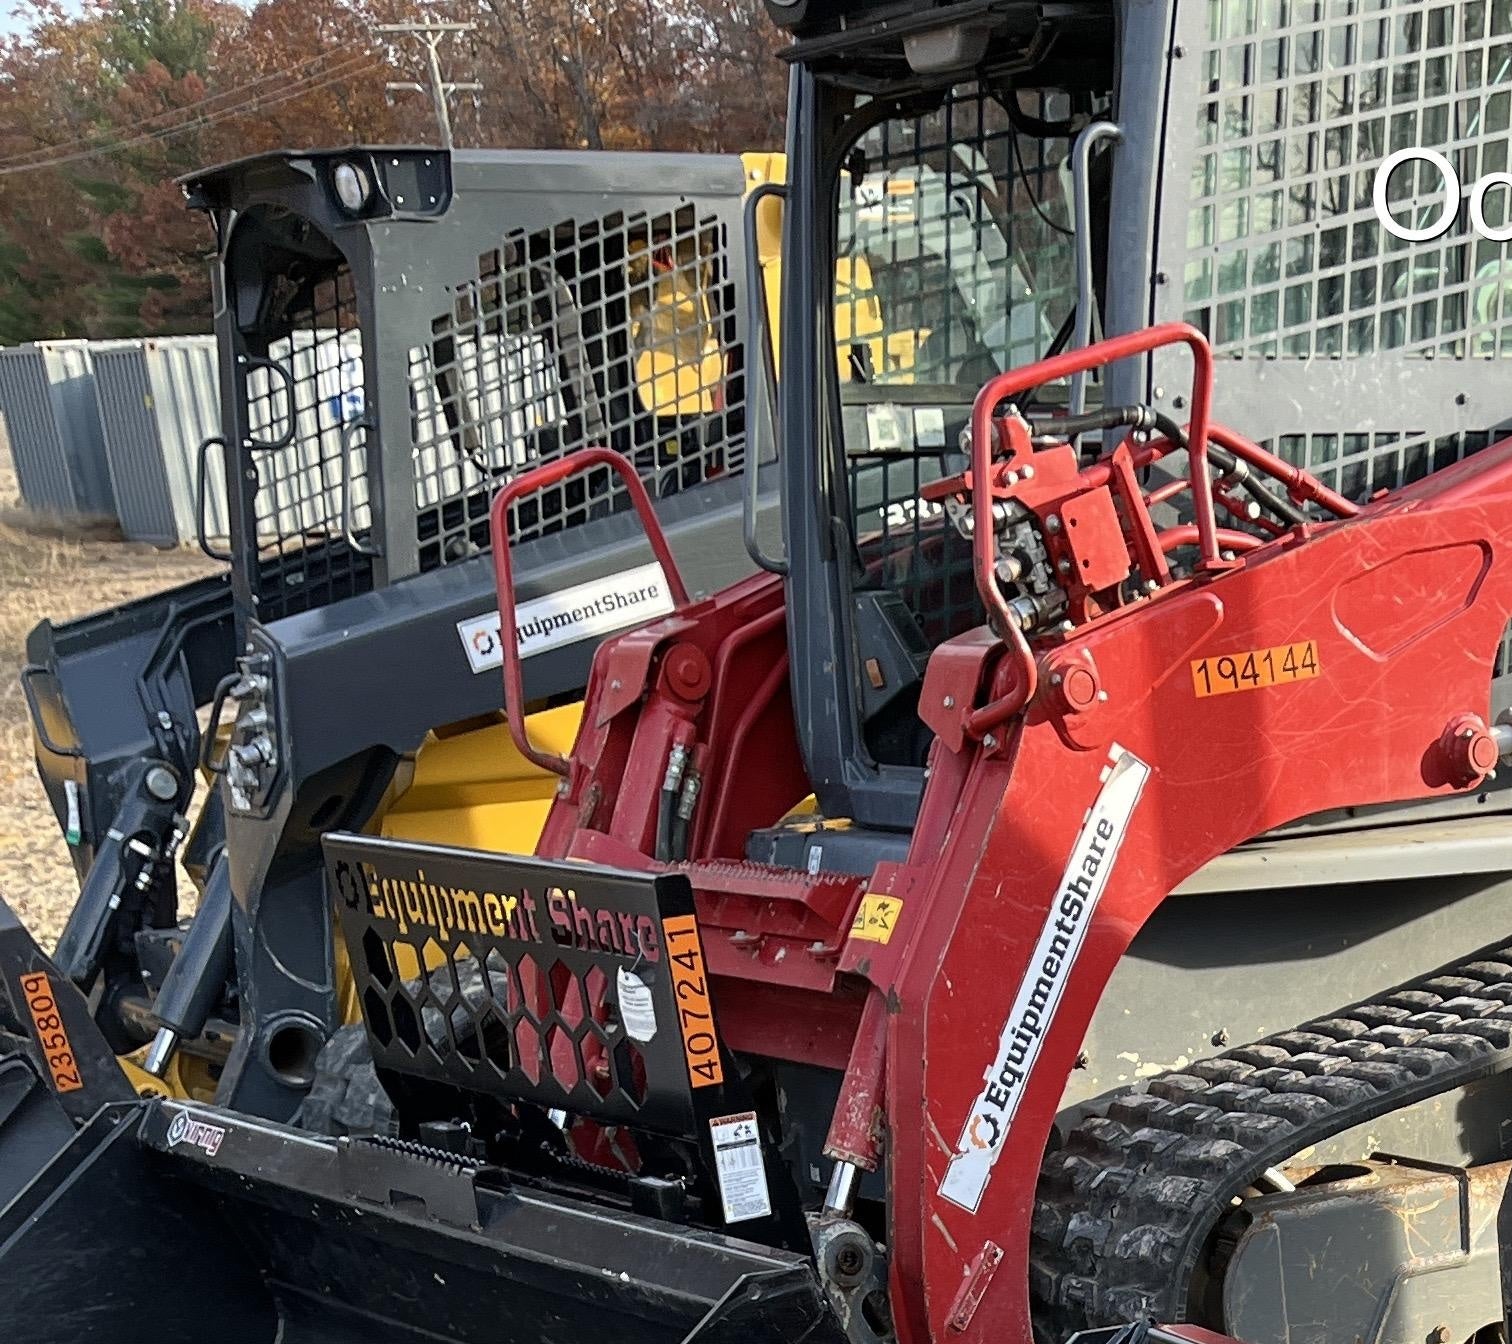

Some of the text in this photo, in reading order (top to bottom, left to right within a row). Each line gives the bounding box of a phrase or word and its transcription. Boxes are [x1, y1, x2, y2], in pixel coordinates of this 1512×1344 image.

[1197, 642, 1317, 694] 194144
[357, 862, 660, 963] Equipment Share
[984, 817, 1115, 1113] EquipmentShare
[24, 976, 80, 1088] 235809
[667, 927, 719, 1081] 407241
